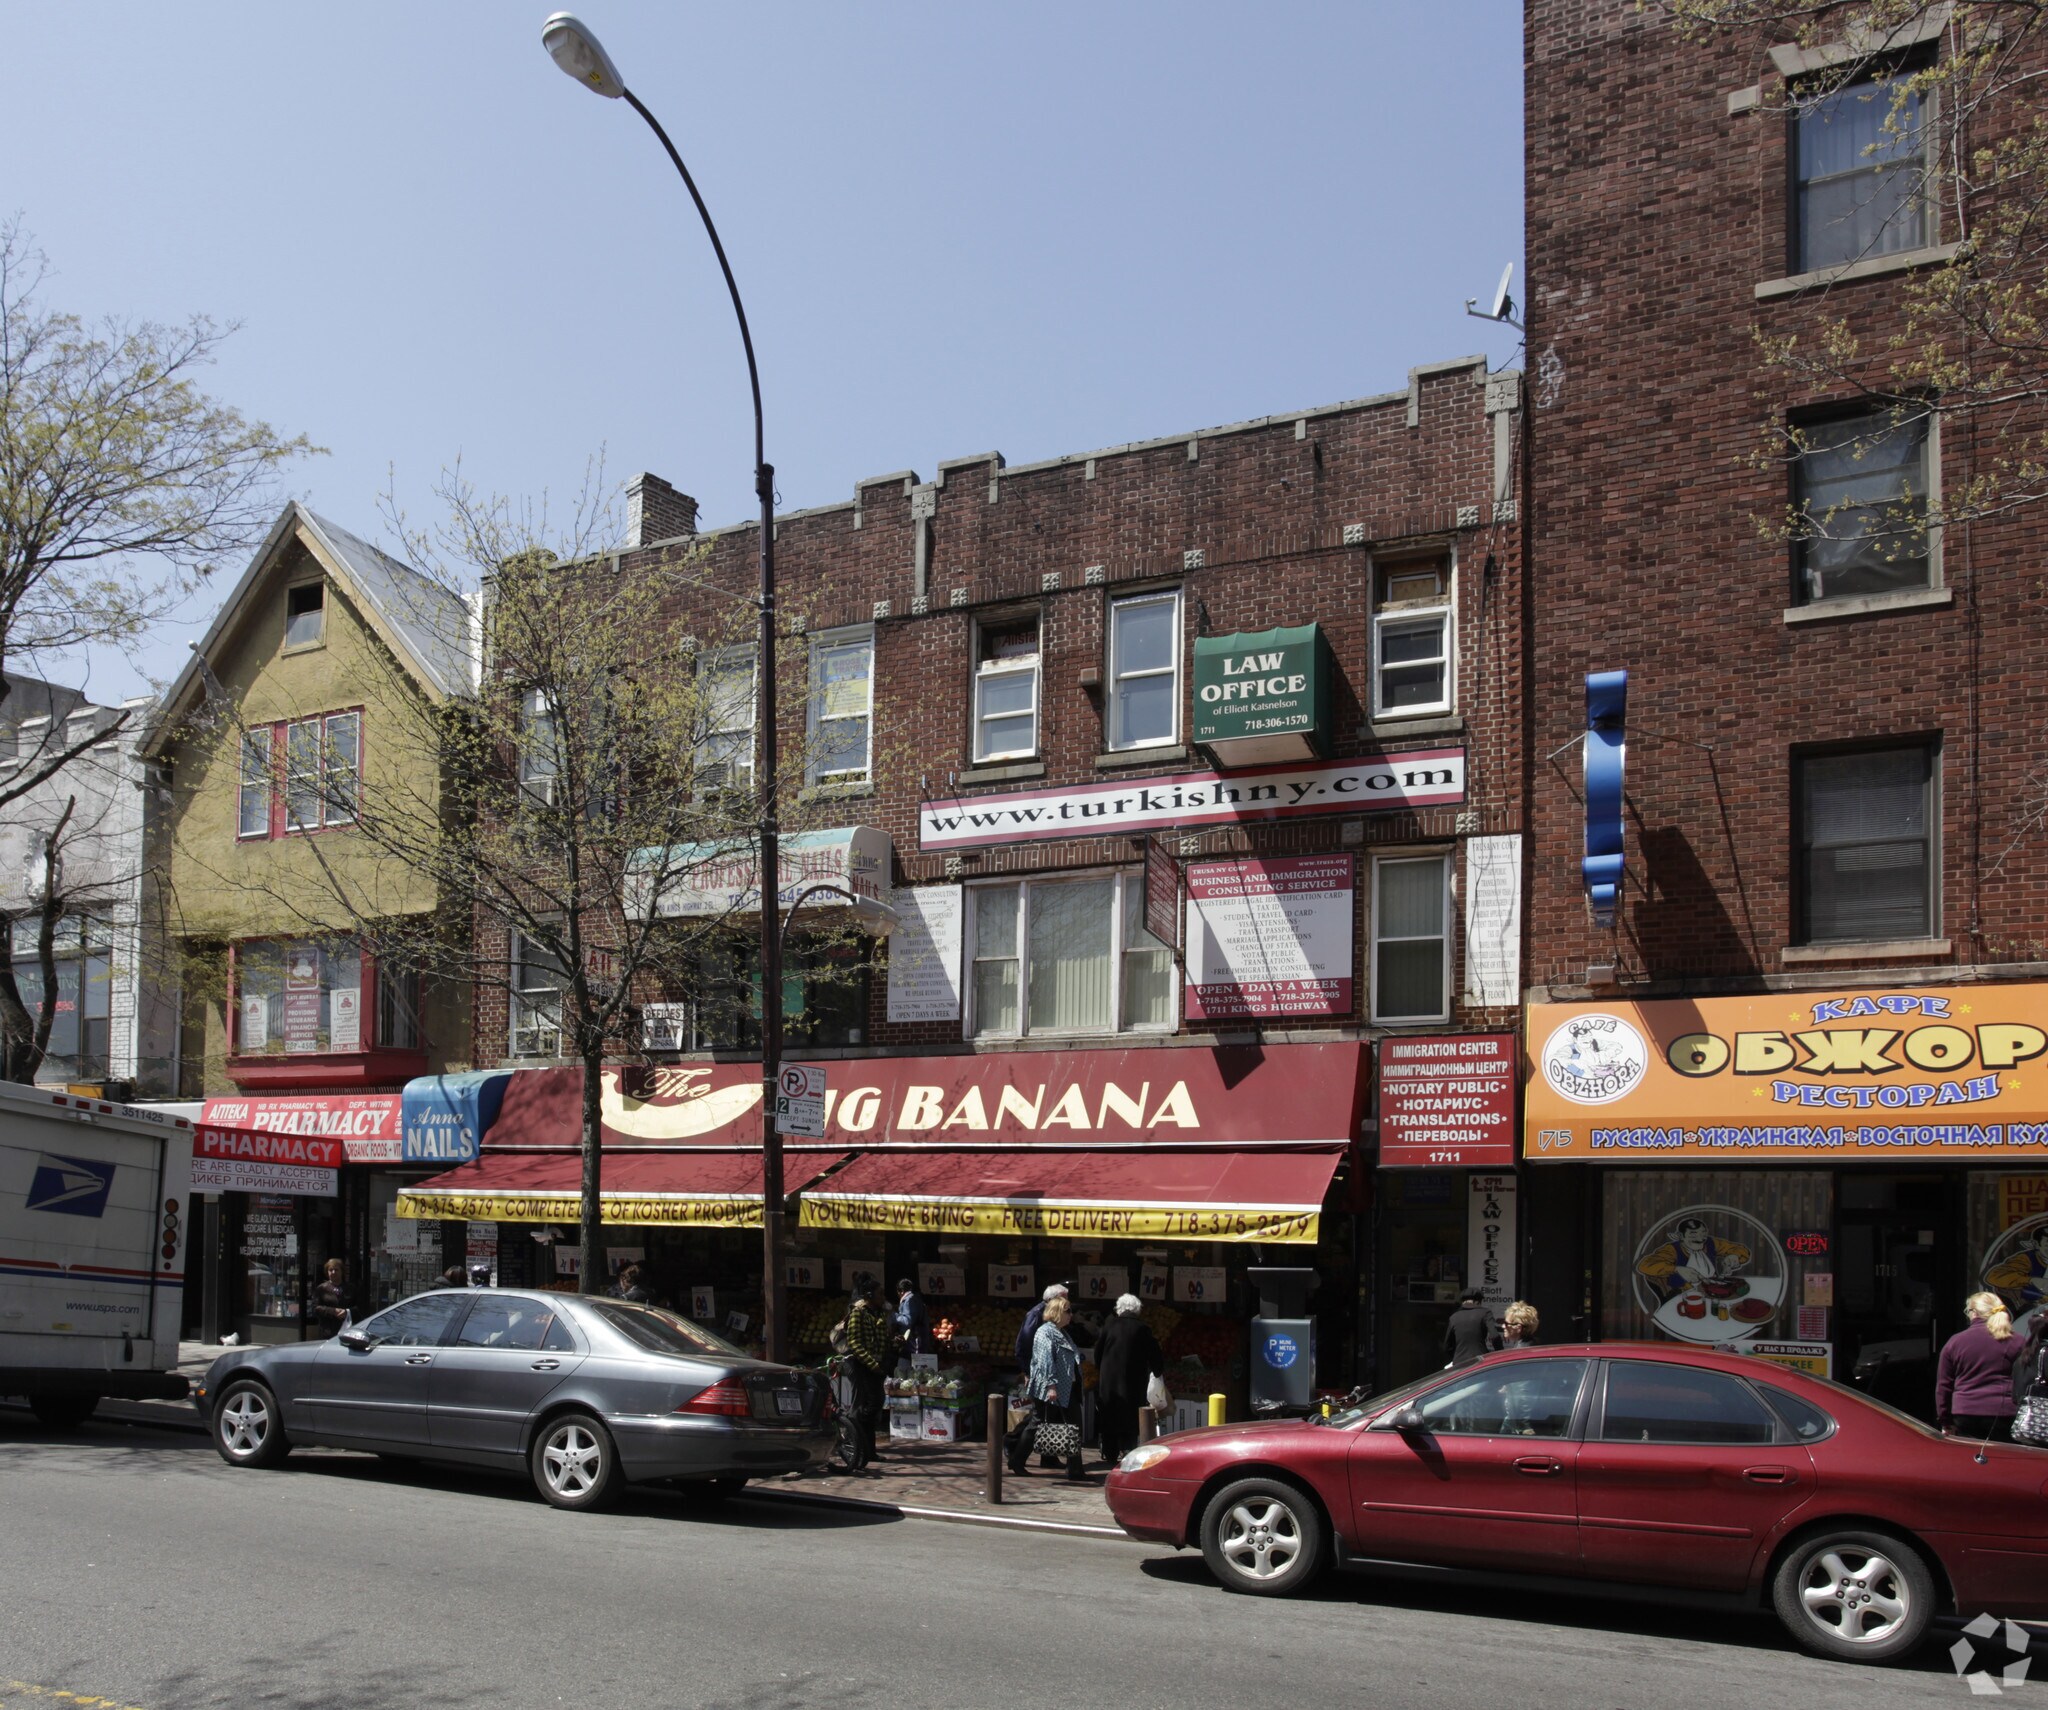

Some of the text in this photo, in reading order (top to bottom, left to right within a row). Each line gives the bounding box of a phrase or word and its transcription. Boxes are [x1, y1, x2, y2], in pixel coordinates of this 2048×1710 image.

[1223, 652, 1285, 675] LAW
[1200, 674, 1307, 702] OFFICE
[1213, 700, 1297, 716] of Elliott Katsnelson
[1200, 714, 1308, 735] 1711 718-306-1570
[928, 766, 1455, 832] www.turkishny.com
[1192, 867, 1215, 875] TRUSA
[1228, 865, 1248, 873] CORP
[1298, 858, 1348, 867] www.trusa.org
[1192, 868, 1348, 887] BUSINESS AND IMMIGRATION
[1207, 880, 1336, 896] CONSULTING SERVICE
[1265, 893, 1322, 903] IDENTIFICATION
[1196, 980, 1339, 995] OPEN 7 DAYS A WEEK
[1196, 991, 1340, 1005] 1-718-375-7904 1-718-375-7905
[896, 1011, 912, 1019] OPEN
[935, 1009, 950, 1017] WEEK
[1206, 1001, 1329, 1014] 1711 KINGS HIGHWAY
[1810, 995, 1953, 1026] КАФЕ
[1393, 1042, 1498, 1058] IMMIGRATION CENTER
[1476, 1061, 1508, 1075] ЦЕНТР
[632, 1067, 713, 1099] The
[1550, 1058, 1641, 1099] OBZHORA
[1389, 1082, 1500, 1095] NOTARY PUBLIC
[1771, 1072, 2003, 1109] РЕСТОРАН
[208, 1103, 249, 1120] АПТЕКА
[279, 1102, 314, 1110] PHARMACY
[369, 1100, 392, 1108] WITHIN
[780, 1098, 787, 1113] 2
[897, 1080, 1201, 1131] BANANA
[1403, 1098, 1482, 1110] НОТАРИУС
[121, 1106, 164, 1123] 3511425
[252, 1110, 390, 1135] PHARMACY
[413, 1106, 464, 1125] Anna
[1390, 1113, 1500, 1126] TRANSLATIONS
[407, 1128, 473, 1158] NAILS
[1404, 1130, 1481, 1142] ПЕРЕВОДЫ
[1538, 1130, 1572, 1151] 1715
[1590, 1126, 1686, 1149] РУССКАЯ
[1698, 1124, 1845, 1149] УКРАИНСКАЯ
[1857, 1123, 2004, 1148] ВОСТОЧНАЯ
[204, 1131, 335, 1162] PHARMACY
[346, 1143, 388, 1158] ORGANIC FOODS
[1429, 1152, 1461, 1162] 1711
[210, 1162, 331, 1180] ARE GLADLY ACCEPTED
[236, 1176, 329, 1191] ПРИНИМАЕТСЯ
[505, 1199, 574, 1218] COMPLETE
[611, 1201, 630, 1219] OF
[633, 1201, 689, 1221] KOSHER
[1482, 1193, 1502, 1219] LAW
[255, 1214, 272, 1223] GLADLY
[273, 1215, 291, 1223] ACCEPT
[809, 1202, 1309, 1236] YOU RING WE BRING FREE DELIVERY 718-375-2579
[243, 1224, 266, 1233] MEDICARE
[1786, 1236, 1828, 1251] OPEN
[1483, 1224, 1500, 1285] OFFICES
[66, 1301, 140, 1314] www.usps.com
[1270, 1339, 1277, 1350] P
